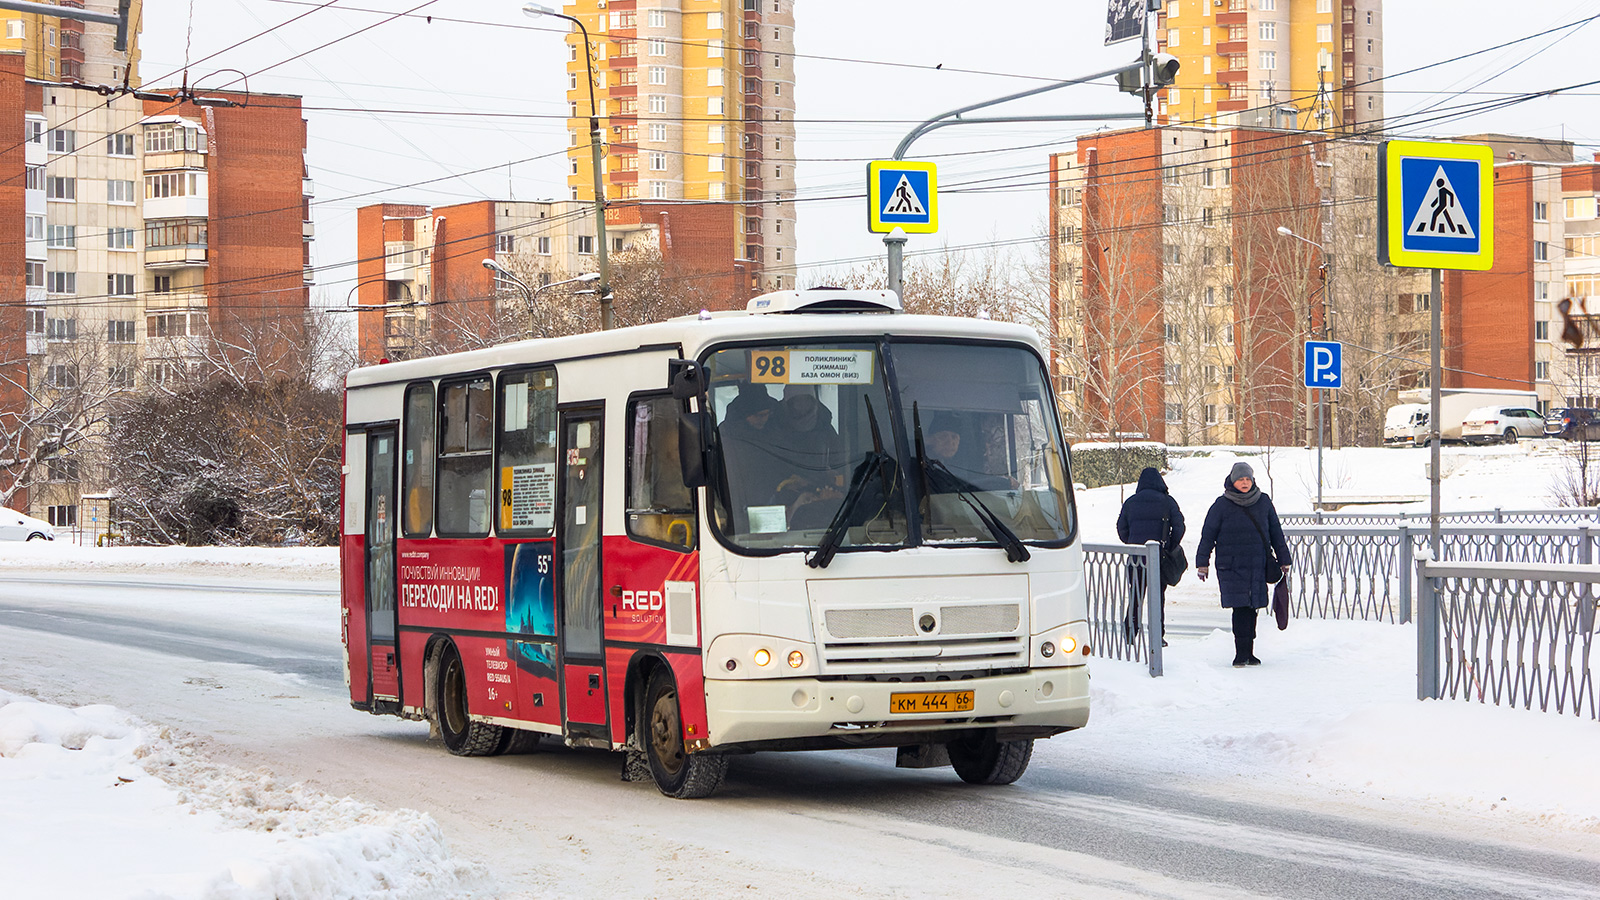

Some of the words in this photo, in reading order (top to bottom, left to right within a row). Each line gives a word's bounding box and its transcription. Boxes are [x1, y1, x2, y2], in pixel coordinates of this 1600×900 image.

[755, 356, 786, 377] 98
[1313, 347, 1333, 382] P
[502, 488, 512, 507] 98
[401, 563, 439, 580] ПОЧУВСТВУЙ
[439, 566, 481, 583] ИННОВАЦИИ!
[537, 555, 552, 574] 55"
[402, 584, 455, 613] ПЕРЕХОДИ
[457, 585, 473, 610] НА
[474, 586, 499, 611] RED!
[622, 590, 663, 611] RED
[631, 614, 664, 623] SOLUTION
[485, 646, 501, 657] УМНЫЙ
[486, 659, 509, 671] ТЕЛЕВИЗОР
[486, 672, 495, 682] RED
[487, 687, 499, 700] 16+
[898, 699, 916, 711] КМ
[922, 695, 948, 710] 444
[956, 693, 969, 704] 66
